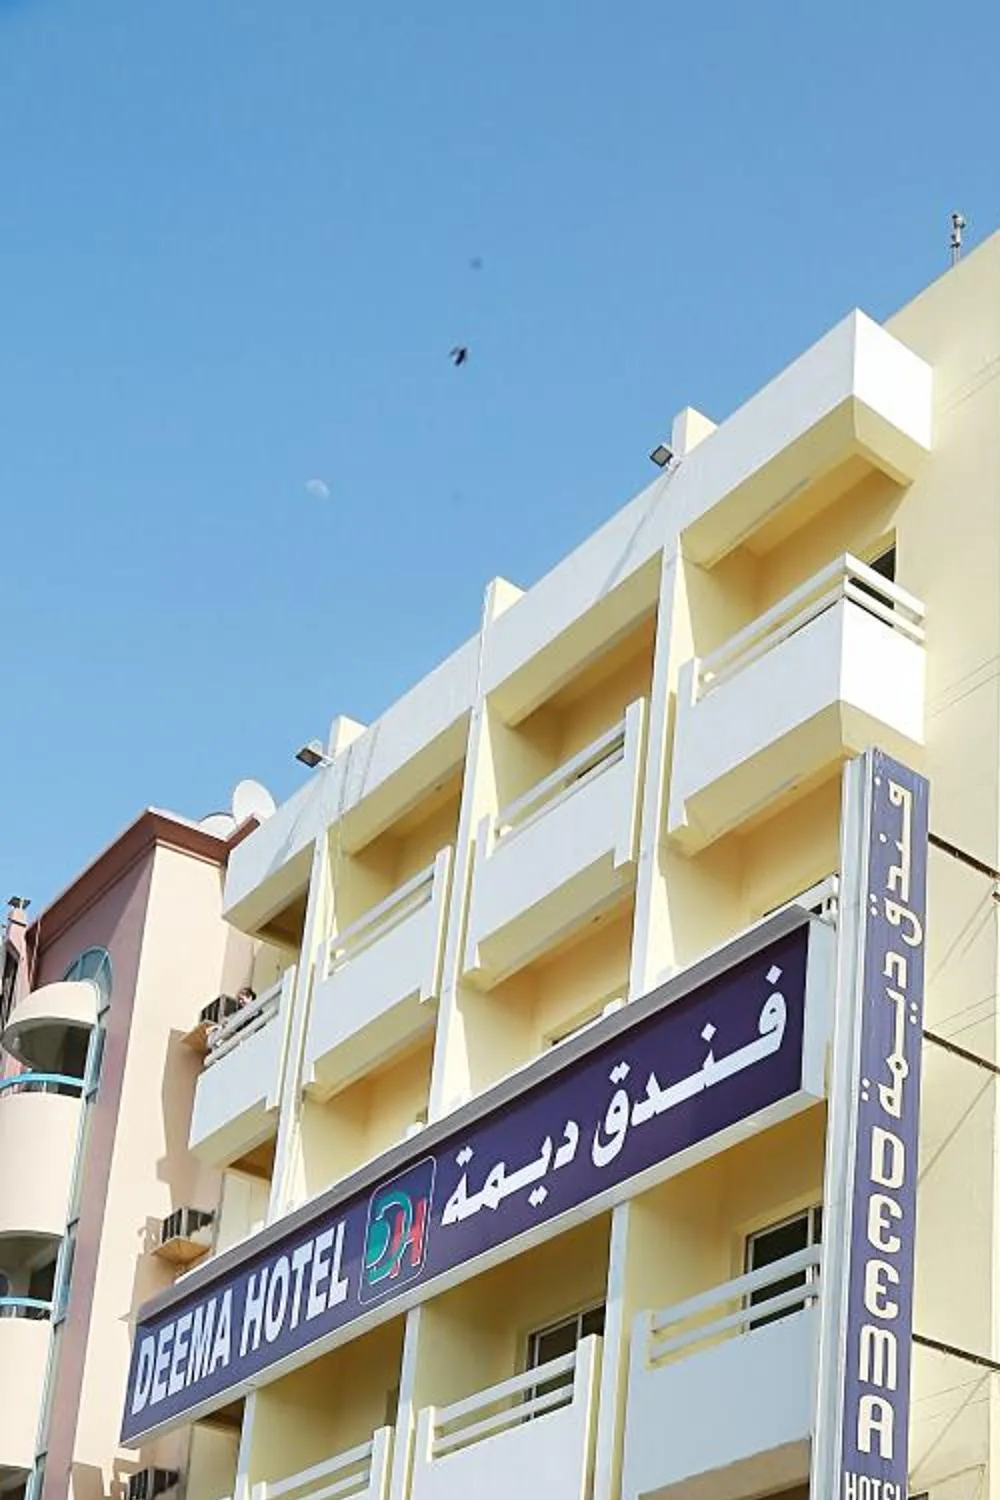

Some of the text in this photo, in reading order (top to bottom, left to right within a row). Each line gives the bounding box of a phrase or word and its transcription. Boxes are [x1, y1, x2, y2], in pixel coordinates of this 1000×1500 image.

[440, 965, 788, 1226] فندق ديمة
[132, 1220, 349, 1415] DEEMA HOTEL
[856, 1125, 905, 1460] DEEMA
